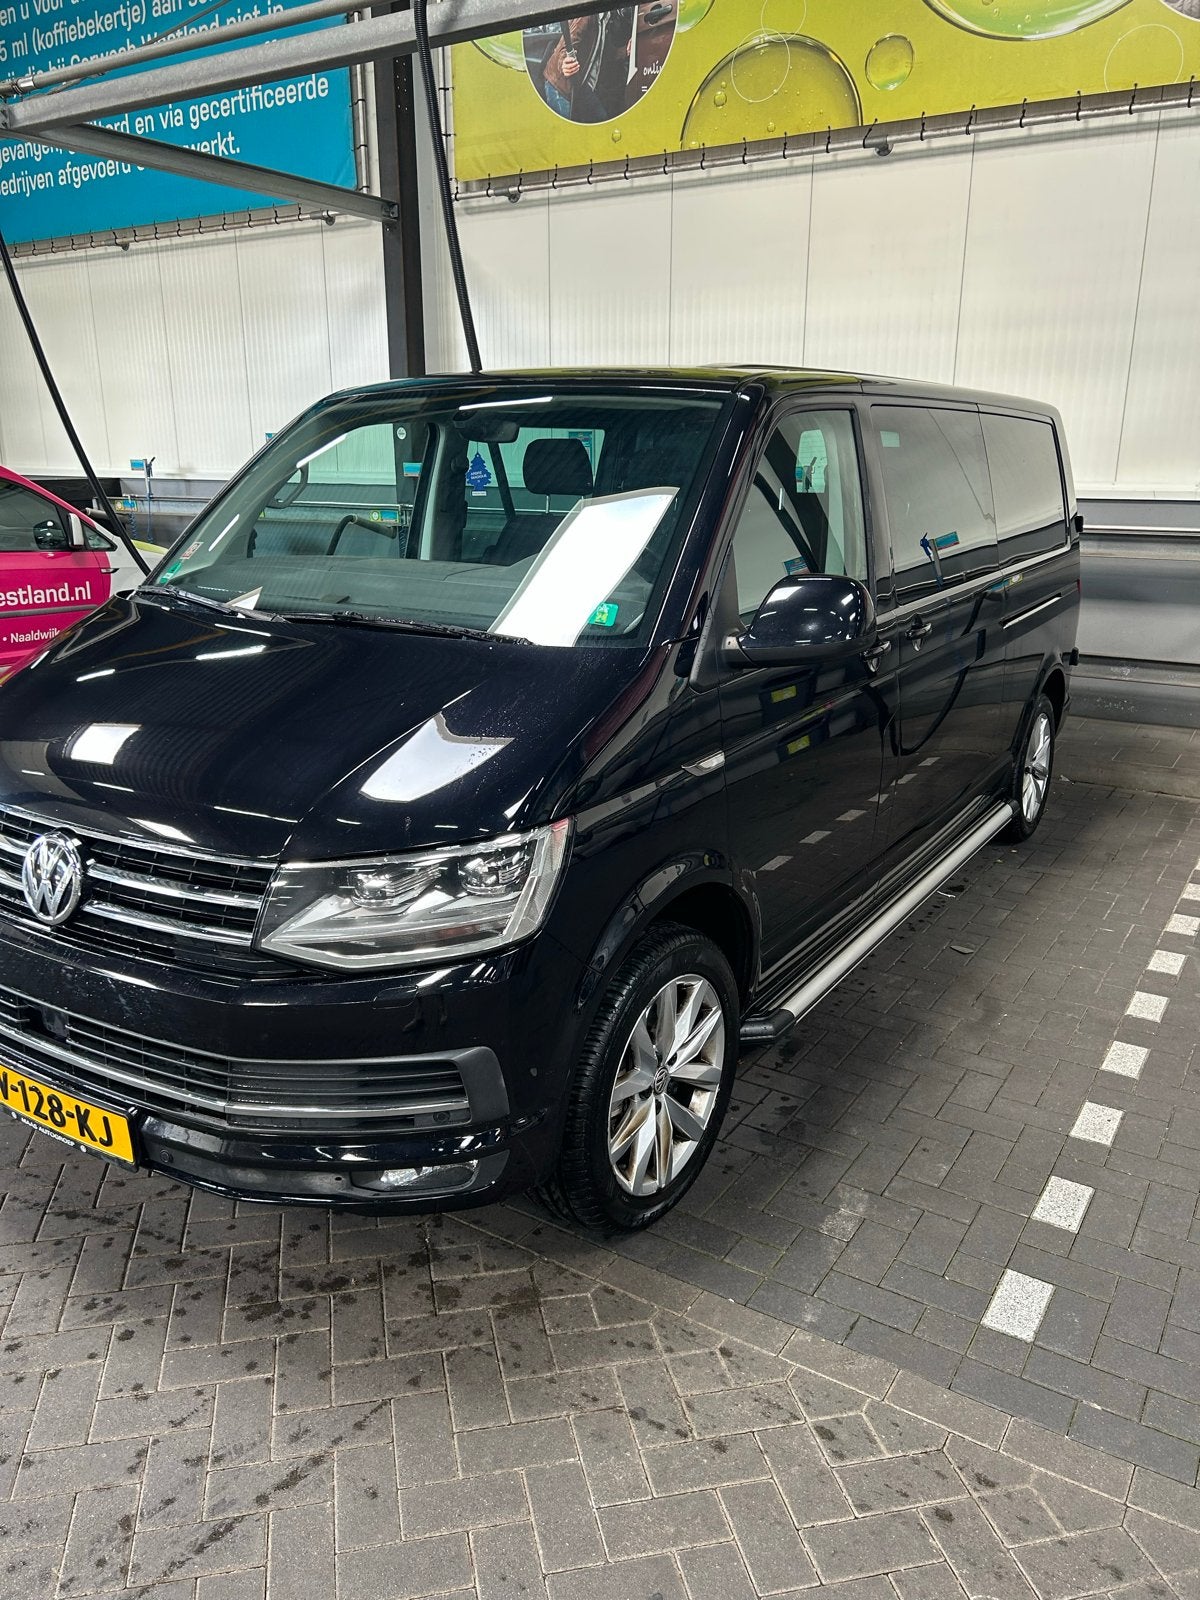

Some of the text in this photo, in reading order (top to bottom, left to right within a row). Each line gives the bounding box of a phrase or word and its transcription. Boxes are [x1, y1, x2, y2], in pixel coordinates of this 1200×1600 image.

[12, 32, 29, 59] ml
[32, 1, 147, 56] (koffiebekertje)
[20, 2, 30, 20] u
[135, 114, 155, 135] en
[159, 103, 184, 128] via
[190, 73, 329, 130] gecertificeerde
[0, 170, 54, 198] edrijven
